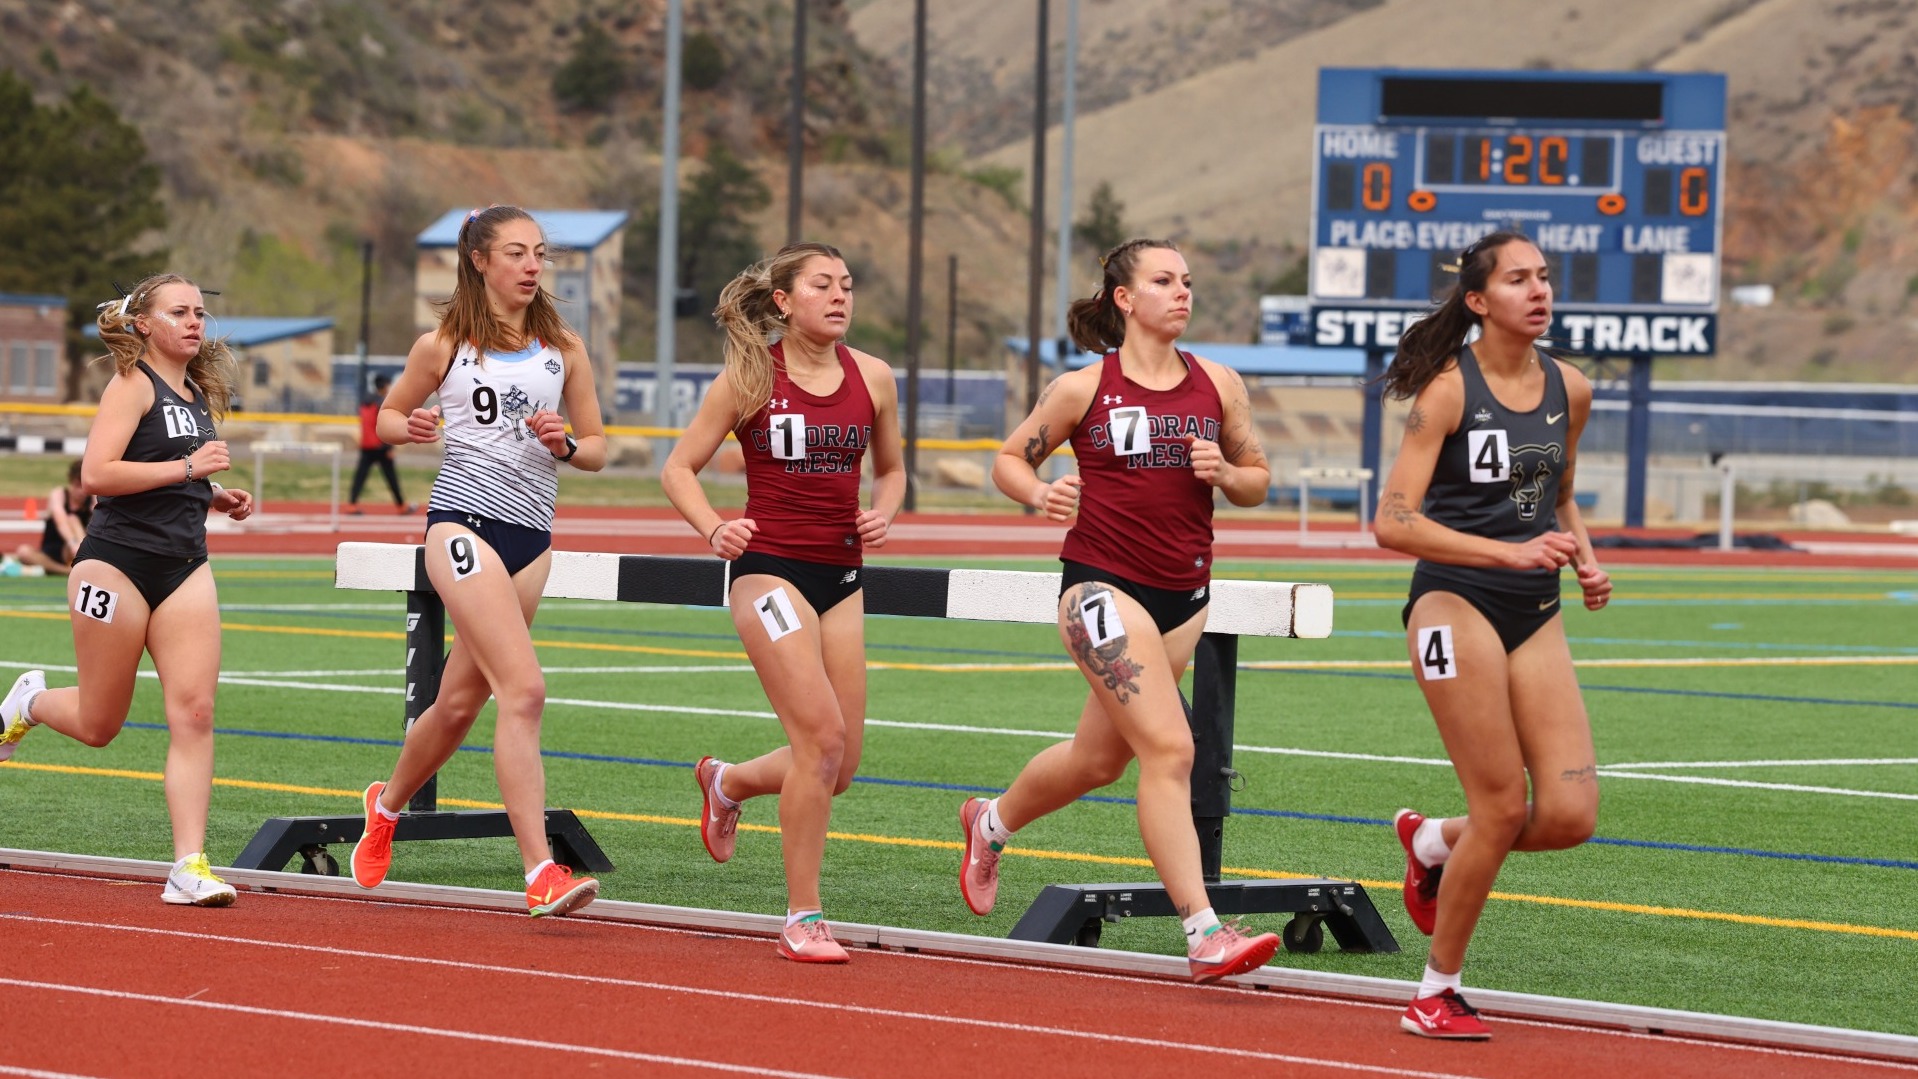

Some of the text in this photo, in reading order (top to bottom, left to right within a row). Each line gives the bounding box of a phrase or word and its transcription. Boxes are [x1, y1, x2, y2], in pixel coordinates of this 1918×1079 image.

[1323, 132, 1399, 158] HOME
[1637, 137, 1717, 164] GUEST
[1362, 162, 1392, 211] 0
[1680, 167, 1709, 216] 0
[1330, 220, 1410, 250] PLACE
[1538, 224, 1603, 252] HEAT
[1623, 225, 1691, 252] LANE
[1562, 314, 1709, 352] TRACK
[167, 407, 194, 434] 13
[472, 386, 498, 425] 9
[776, 418, 793, 457] 1
[1089, 415, 1222, 449] CORAD
[1115, 410, 1140, 451] 7
[785, 452, 856, 473] MESA
[1475, 434, 1503, 478] 4
[451, 537, 475, 575] 9
[81, 585, 111, 619] 13
[761, 595, 790, 632] 1
[1084, 597, 1107, 641] 7
[1424, 630, 1449, 675] 4
